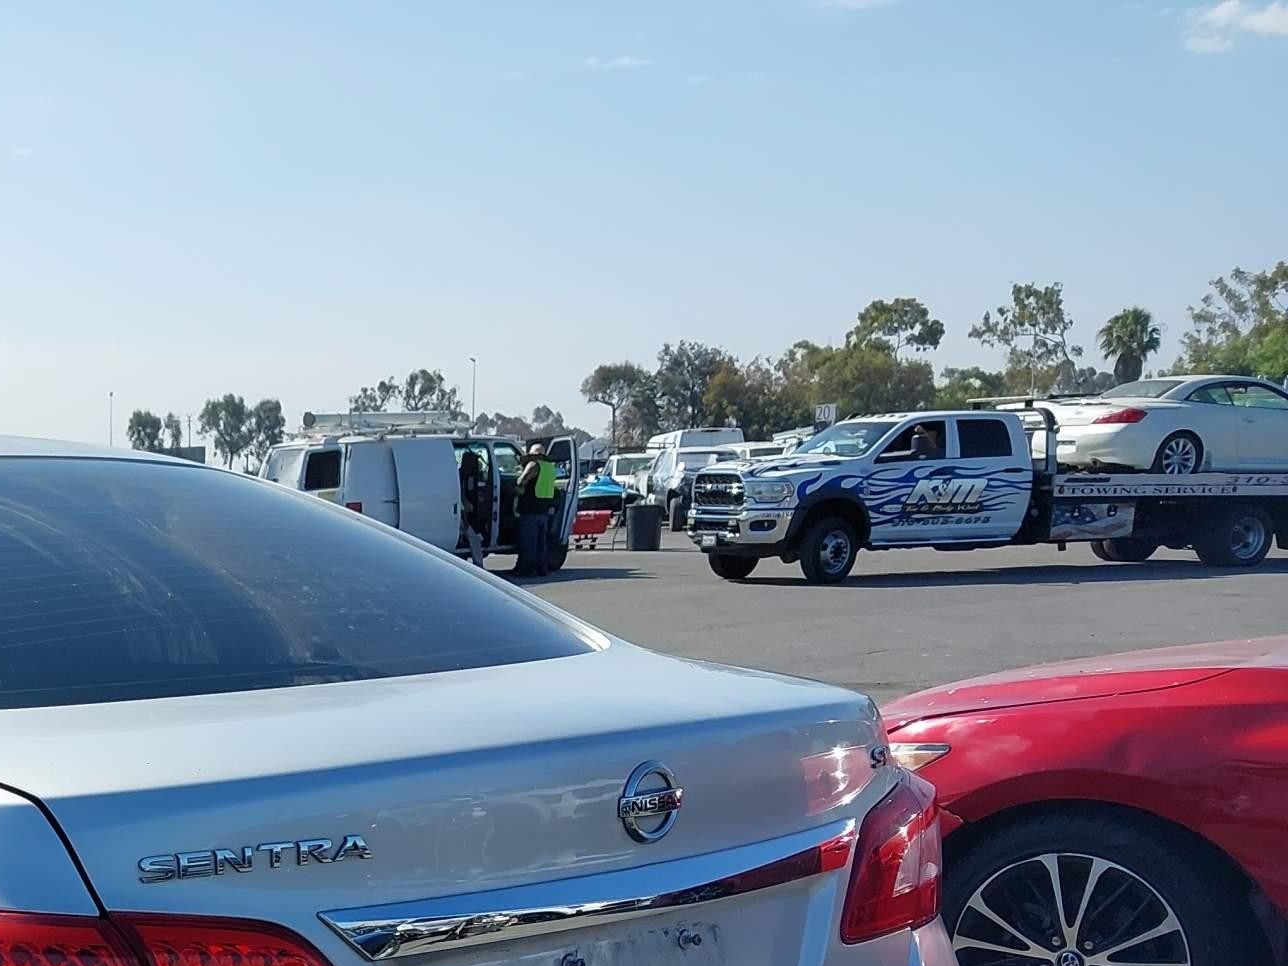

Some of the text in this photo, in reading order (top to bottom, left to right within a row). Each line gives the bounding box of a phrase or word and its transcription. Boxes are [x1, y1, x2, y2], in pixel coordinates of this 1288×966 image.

[816, 406, 830, 420] 20
[1066, 486, 1232, 495] TOWING SERVICE
[631, 791, 681, 813] NISSAN
[138, 834, 373, 884] SENTRA
